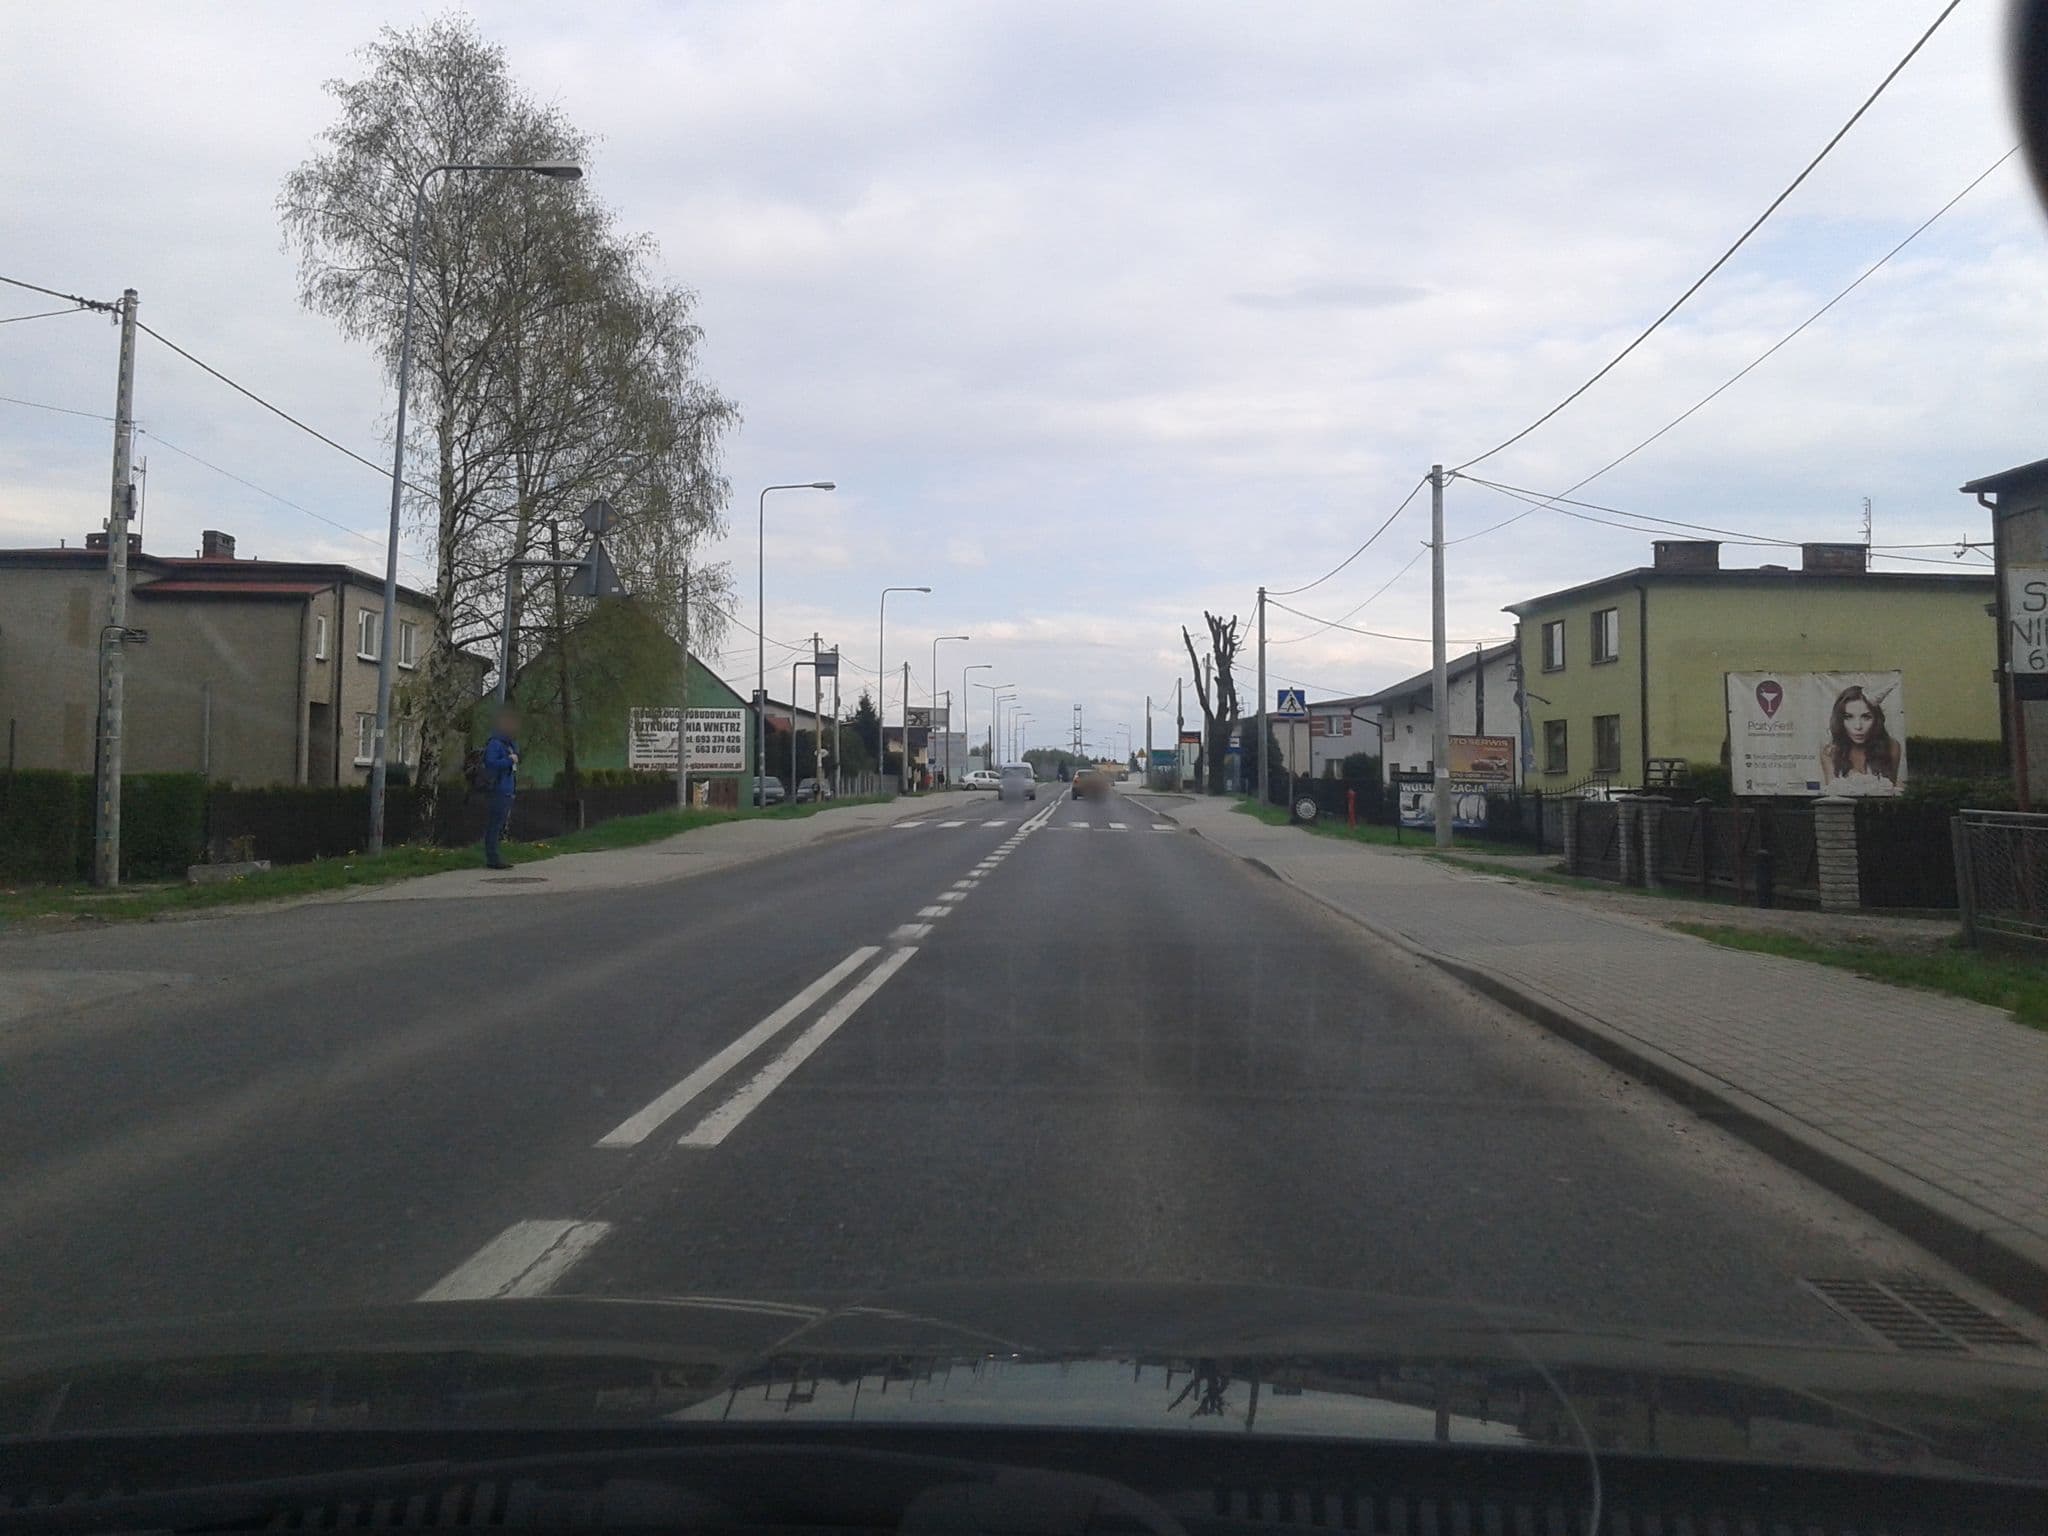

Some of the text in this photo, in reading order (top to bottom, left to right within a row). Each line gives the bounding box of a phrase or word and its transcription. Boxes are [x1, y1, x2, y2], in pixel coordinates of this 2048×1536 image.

[634, 721, 741, 734] WYKOŃCZNIA WNĘTRZ
[695, 735, 711, 744] 693
[726, 735, 741, 744] 426
